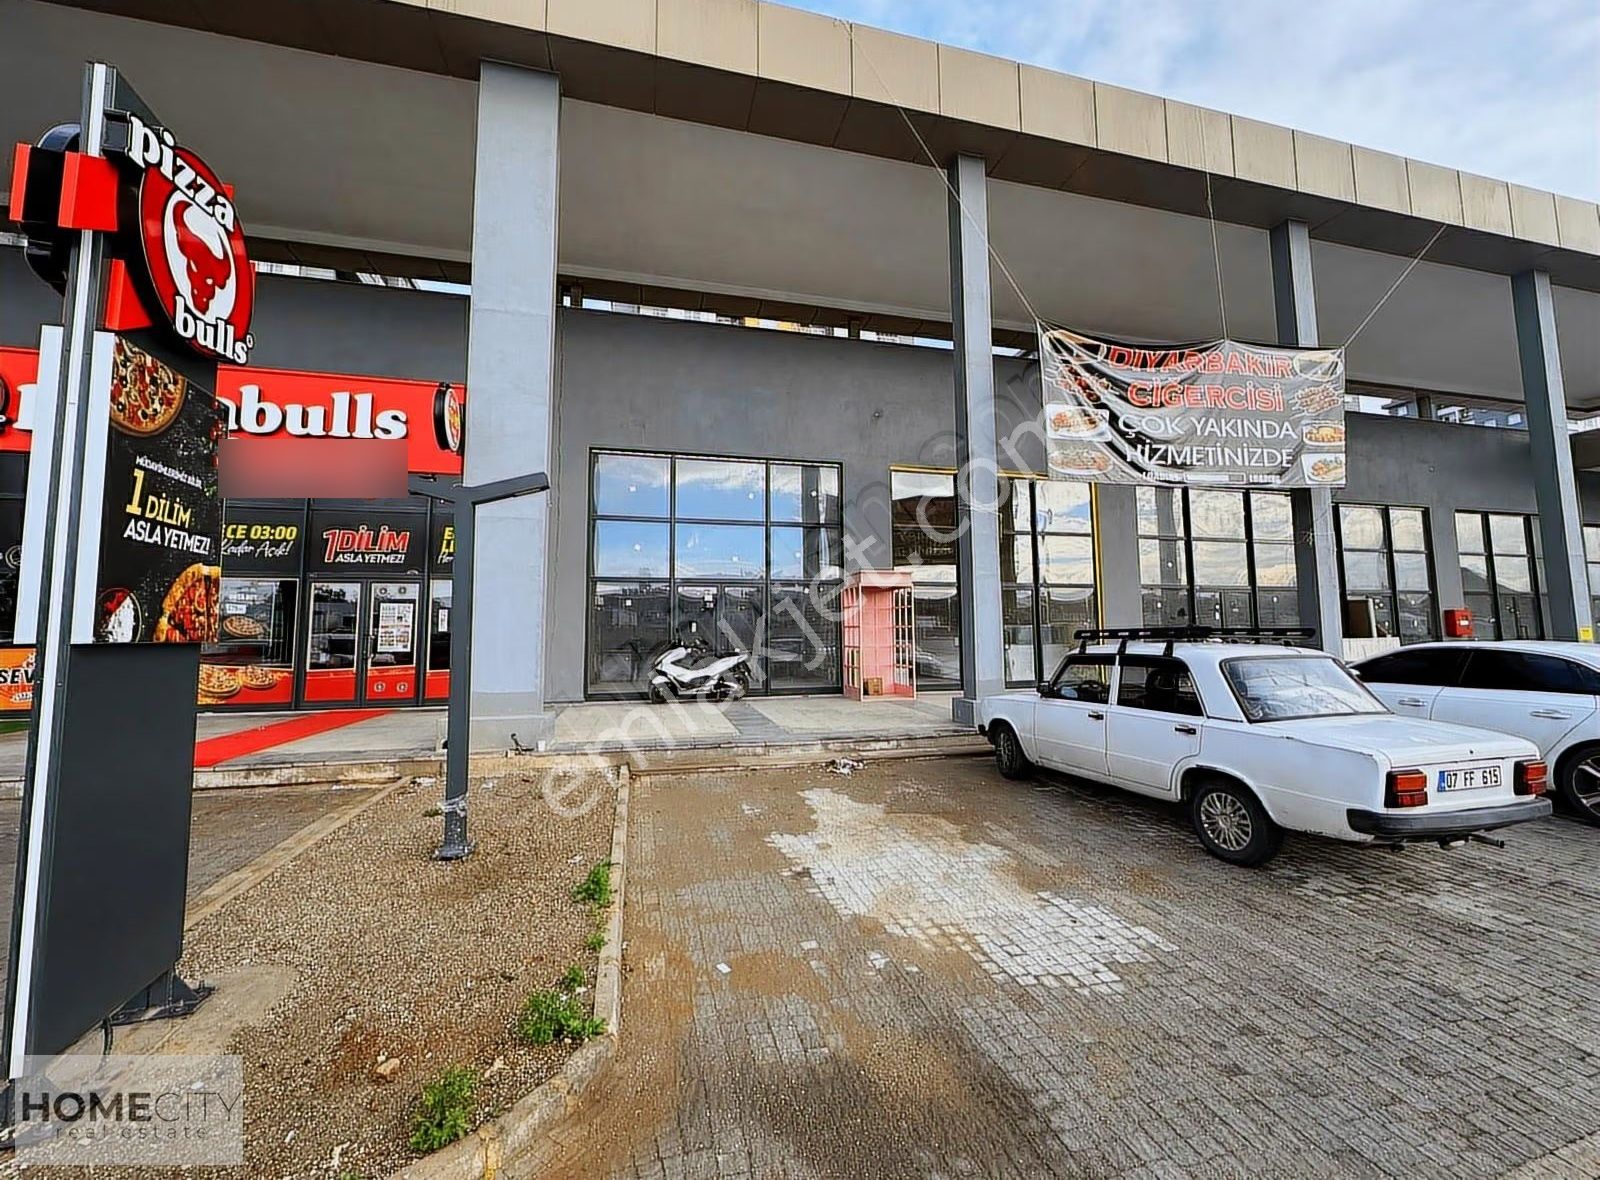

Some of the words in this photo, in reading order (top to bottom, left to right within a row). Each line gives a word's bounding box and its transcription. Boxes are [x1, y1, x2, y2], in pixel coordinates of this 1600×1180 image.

[128, 115, 235, 232] pizza
[174, 296, 248, 364] bulls
[1118, 415, 1188, 438] ÇOK
[1191, 416, 1298, 440] YAKINDA
[1126, 440, 1294, 468] HİZMETİNİZDE
[126, 468, 145, 516] 1
[145, 492, 192, 529] DİLİM
[123, 518, 162, 545] ASLA
[162, 526, 211, 555] YETMEZ!
[223, 524, 248, 540] CE
[250, 524, 298, 541] 03:00
[335, 553, 363, 563] ASLA
[1447, 773, 1458, 788] 07
[1464, 771, 1475, 786] FF
[1482, 769, 1499, 784] 615
